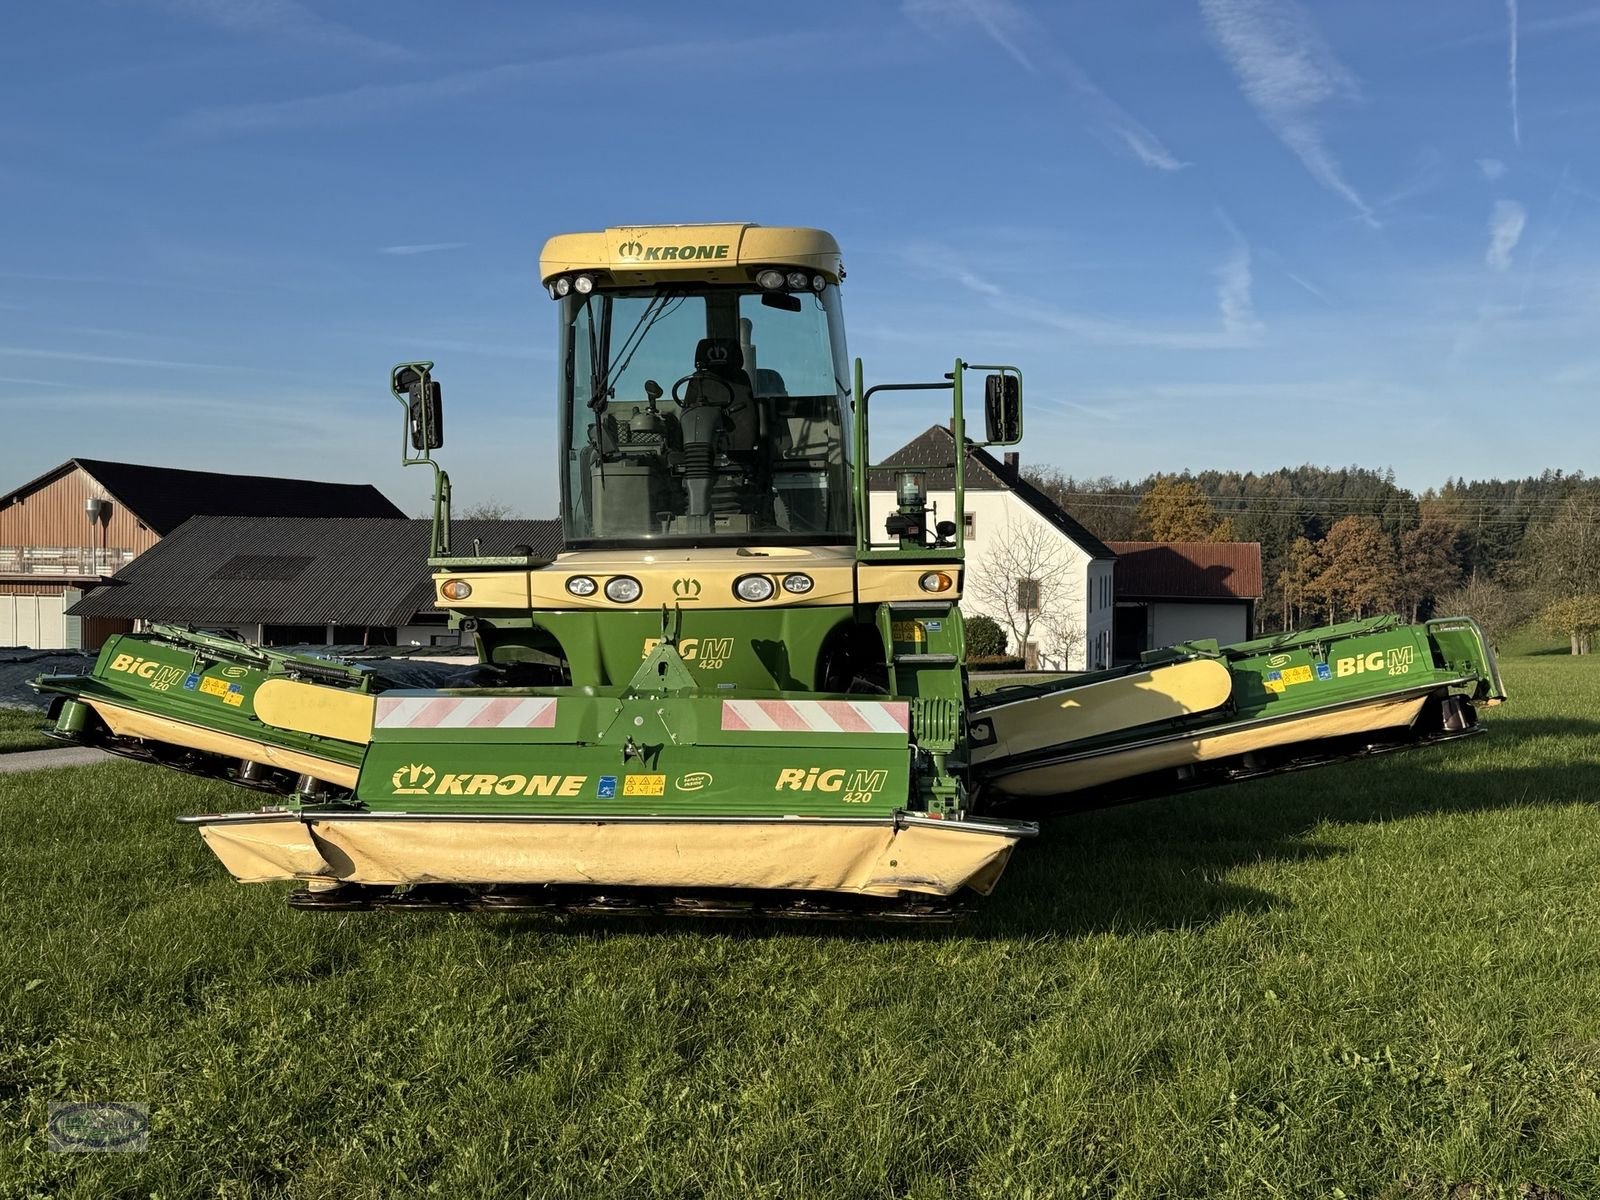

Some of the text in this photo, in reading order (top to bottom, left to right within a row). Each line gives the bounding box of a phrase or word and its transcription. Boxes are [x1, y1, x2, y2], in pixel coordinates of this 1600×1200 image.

[644, 245, 730, 260] KRONE
[699, 659, 723, 669] 420
[1388, 664, 1409, 676] 420
[149, 681, 170, 691] 420
[434, 774, 587, 796] KRONE
[842, 792, 873, 803] 420
